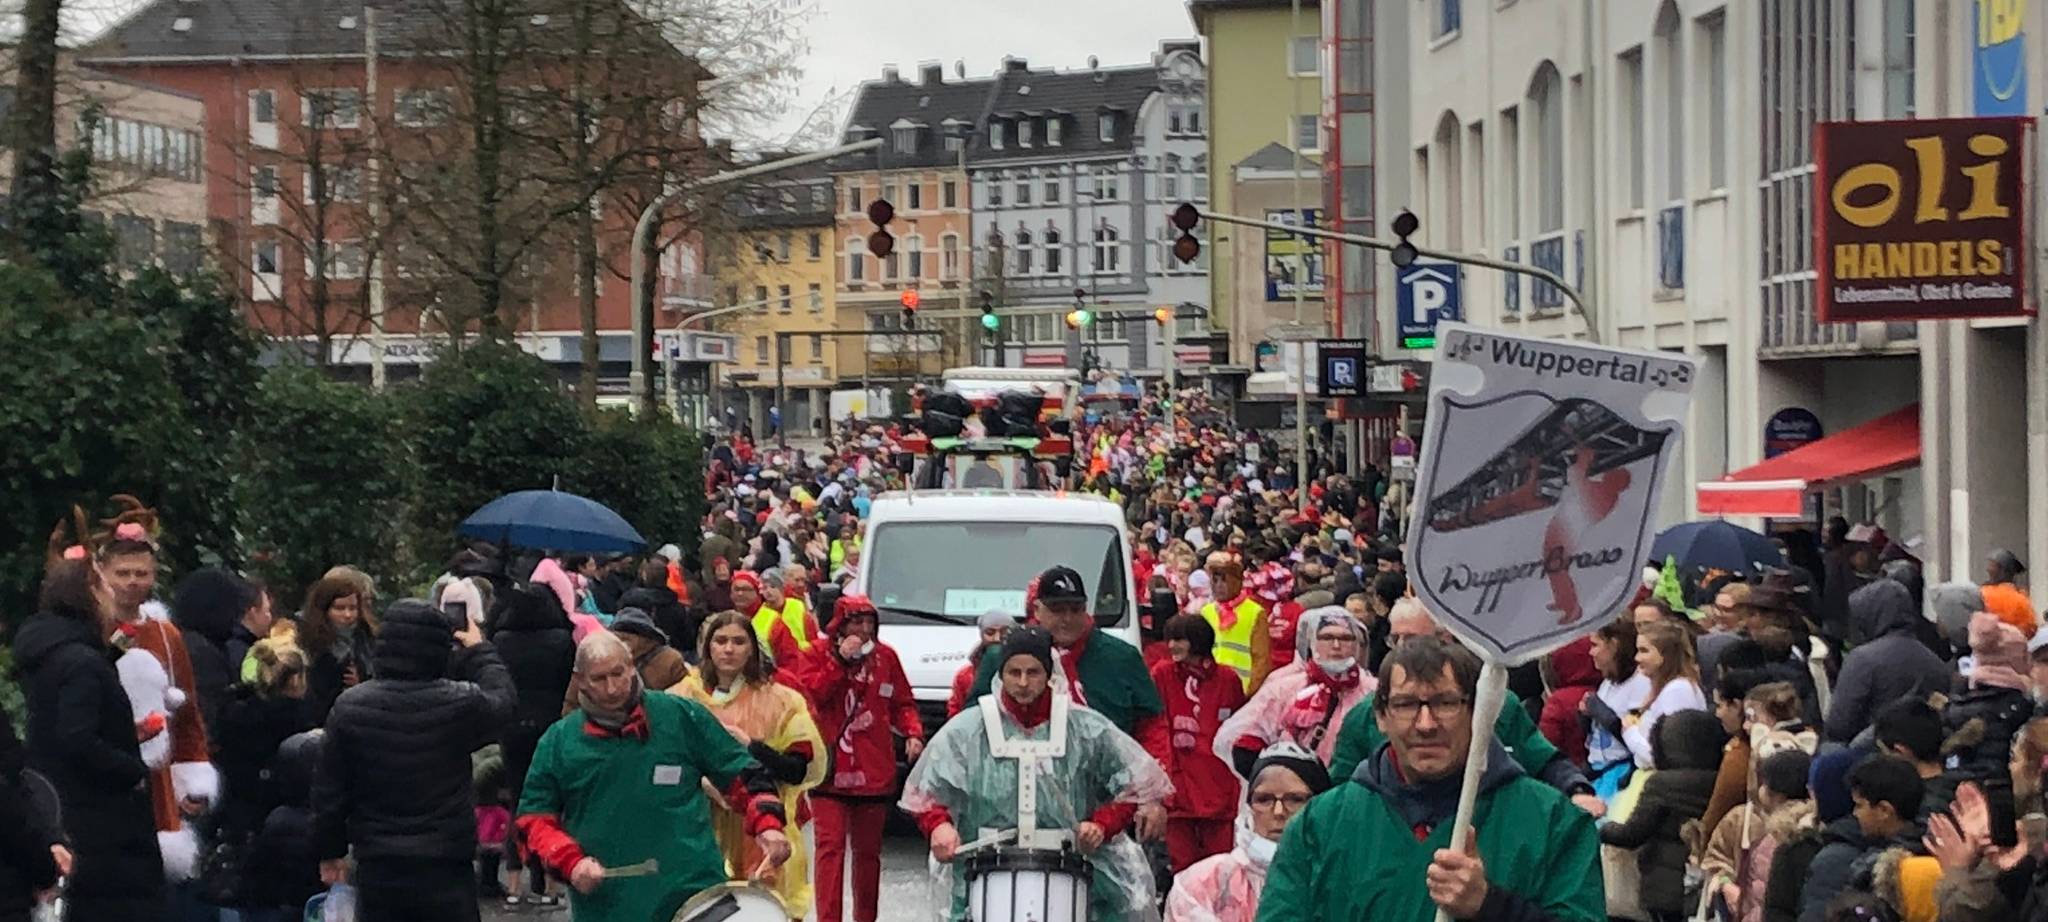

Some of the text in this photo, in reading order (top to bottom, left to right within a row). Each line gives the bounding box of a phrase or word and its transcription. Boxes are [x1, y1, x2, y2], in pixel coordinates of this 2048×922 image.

[1832, 134, 2010, 228] oli
[1834, 239, 2001, 280] HANDELS
[1413, 281, 1447, 323] P
[1492, 338, 1649, 384] Wuppertal
